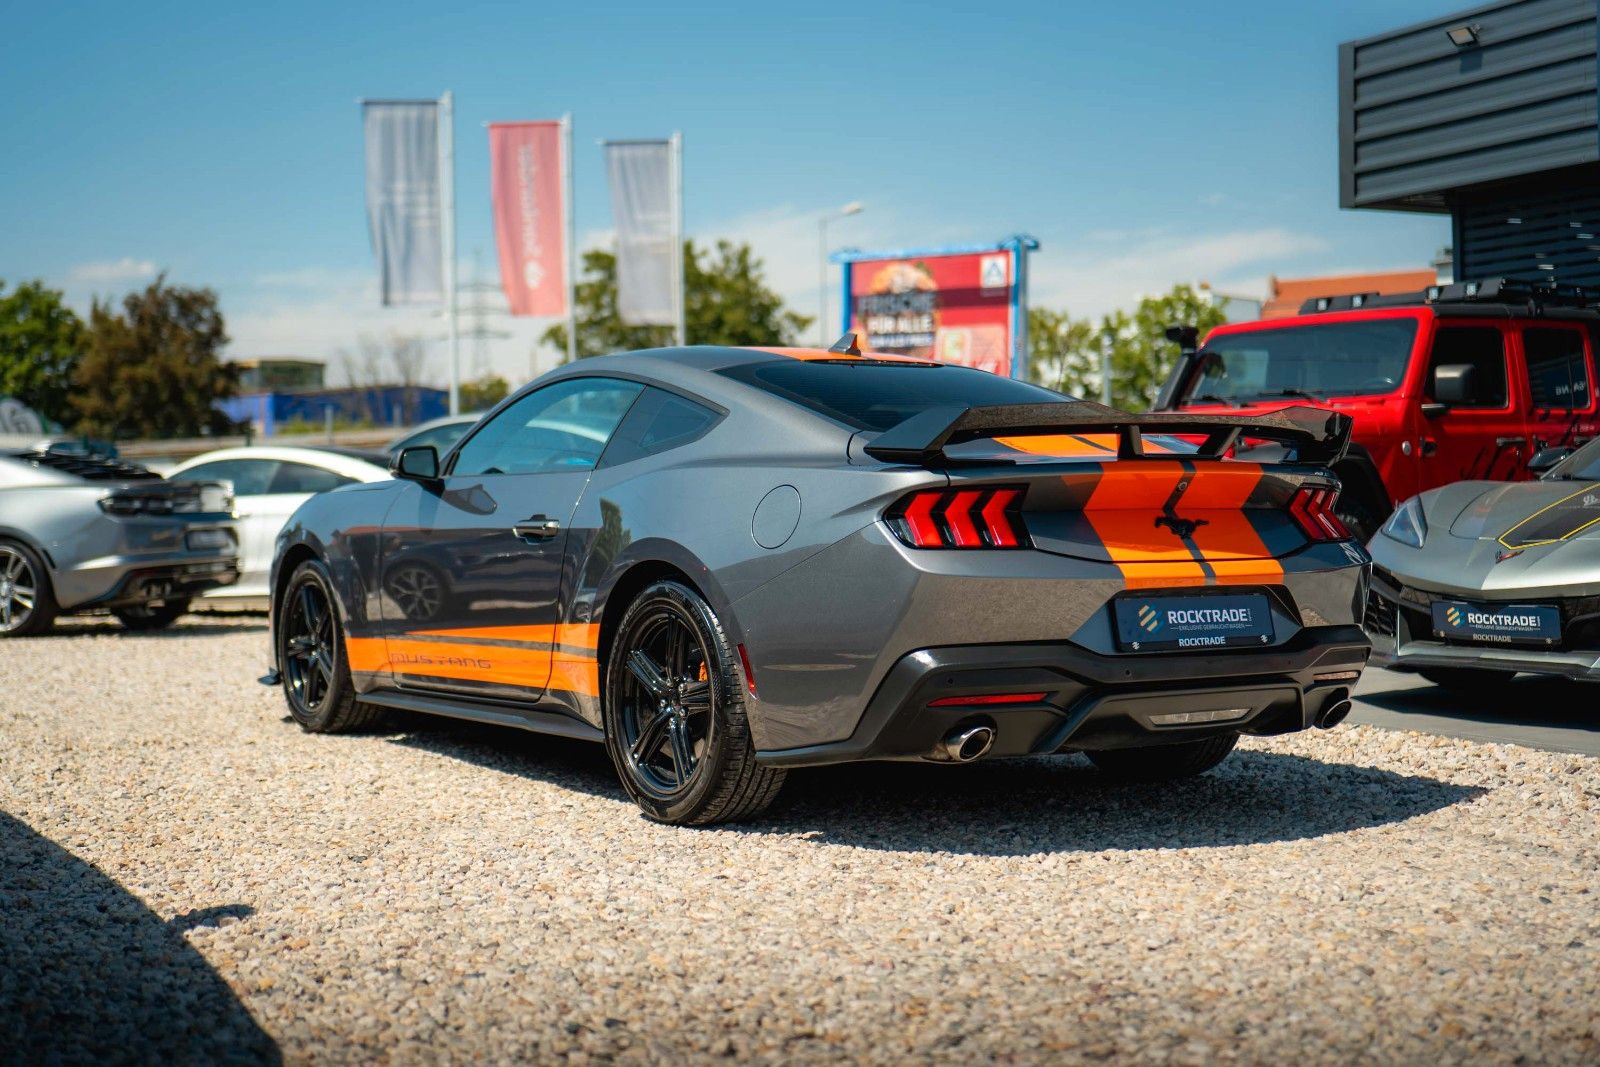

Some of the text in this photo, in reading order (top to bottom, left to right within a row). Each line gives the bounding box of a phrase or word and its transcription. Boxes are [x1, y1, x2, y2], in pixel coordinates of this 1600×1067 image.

[1167, 608, 1248, 624] ROCKTRADE
[1467, 612, 1537, 627] ROCKTRADE
[1178, 636, 1226, 647] ROCKTRADE
[1472, 633, 1512, 643] ROCKTRADE
[391, 652, 491, 669] MUSTANG
